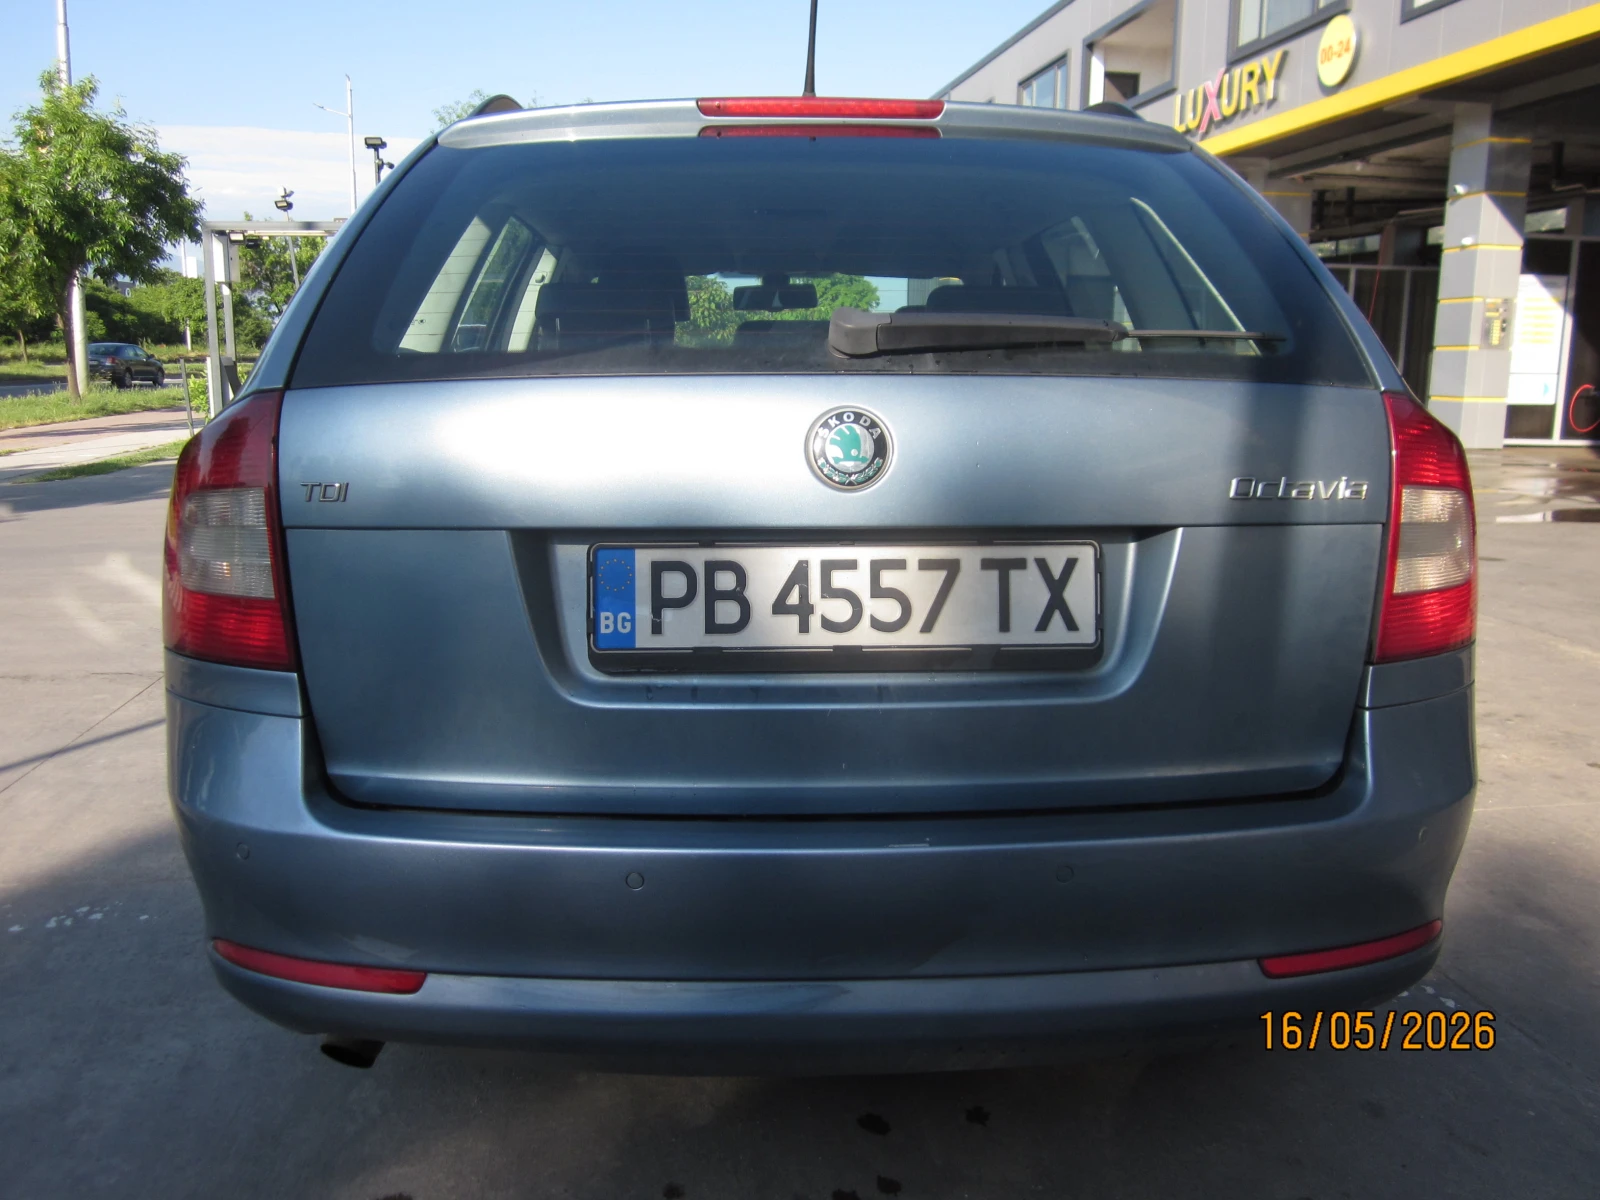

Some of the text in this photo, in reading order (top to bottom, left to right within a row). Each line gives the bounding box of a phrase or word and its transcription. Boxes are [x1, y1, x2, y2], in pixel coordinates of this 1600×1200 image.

[1320, 37, 1351, 64] 00-24
[1174, 49, 1284, 133] LUXURY
[300, 482, 349, 502] TDI
[1229, 476, 1369, 500] Octavia
[650, 557, 1081, 635] PB 4557 TX
[600, 611, 632, 634] BG
